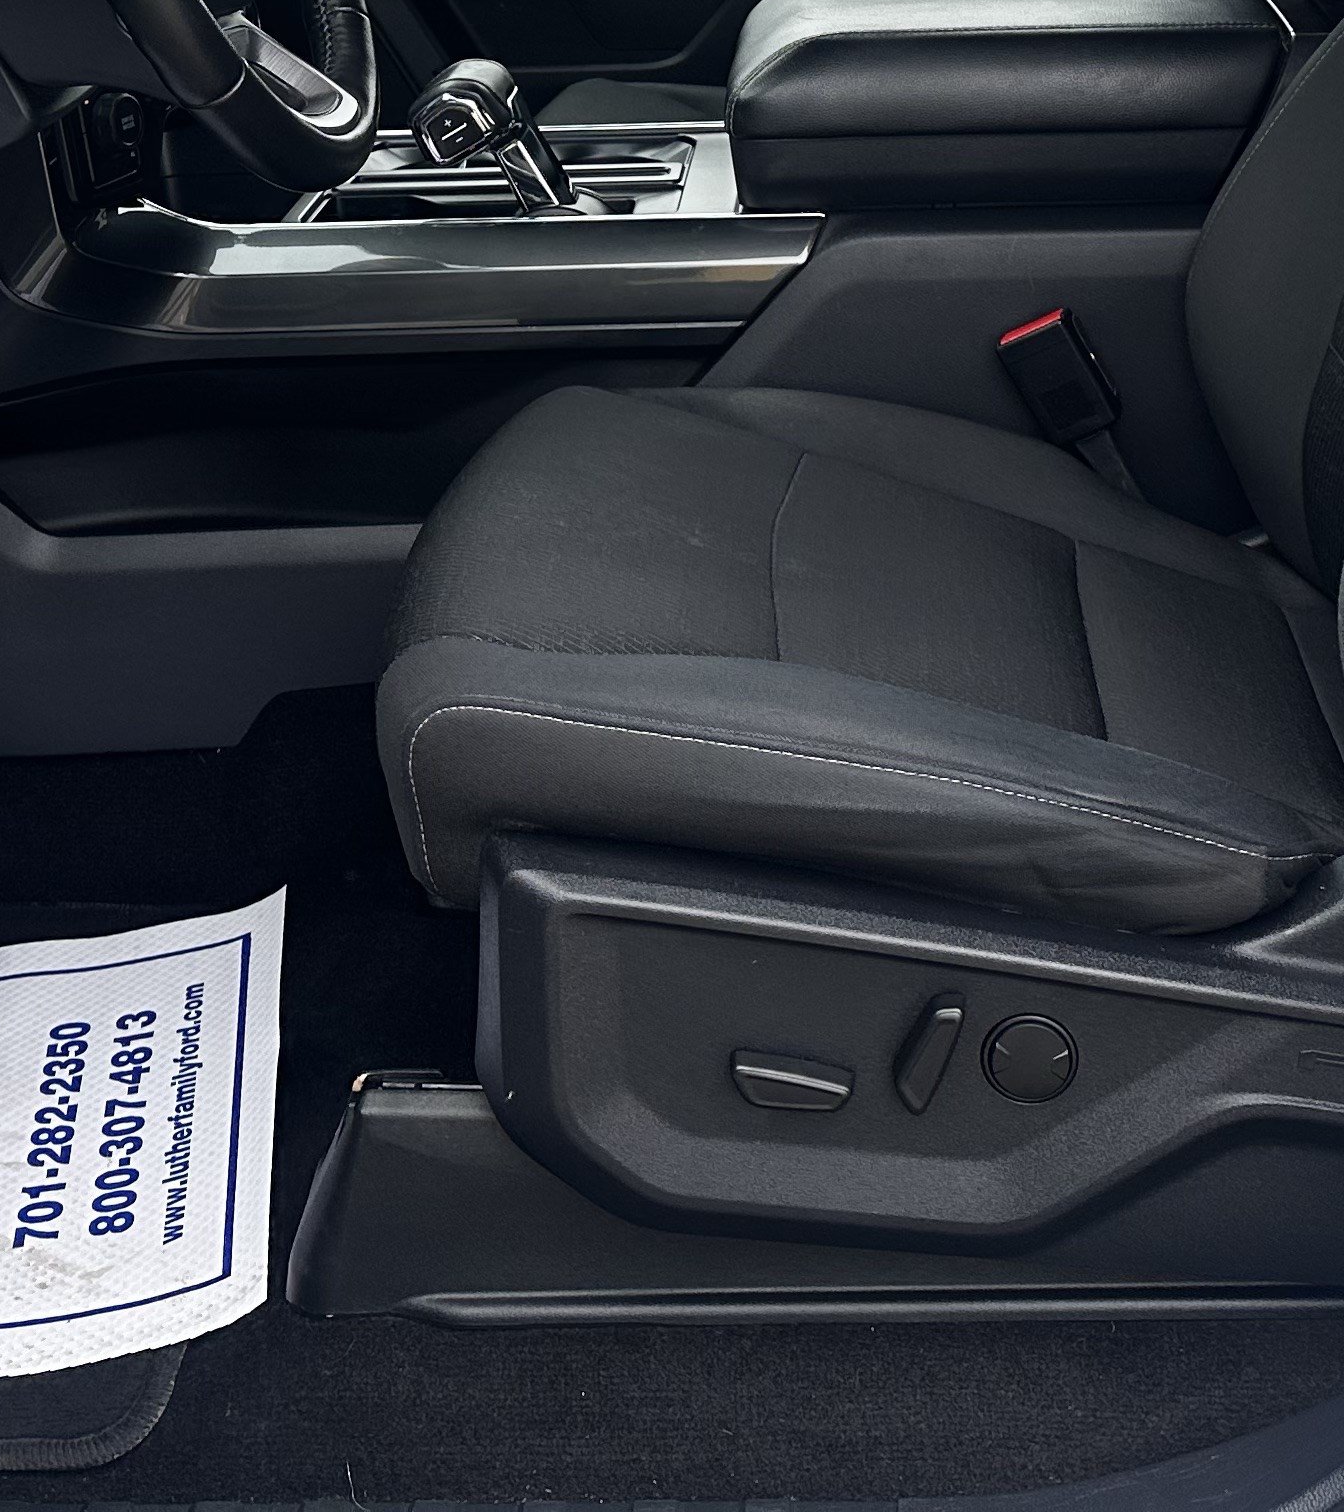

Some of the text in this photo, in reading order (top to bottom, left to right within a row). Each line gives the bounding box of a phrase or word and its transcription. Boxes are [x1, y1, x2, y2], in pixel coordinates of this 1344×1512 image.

[13, 1022, 91, 1248] 701-282-2350
[89, 1010, 157, 1236] 800-307-4813
[162, 982, 204, 1245] www.lutherfamilyford.com
